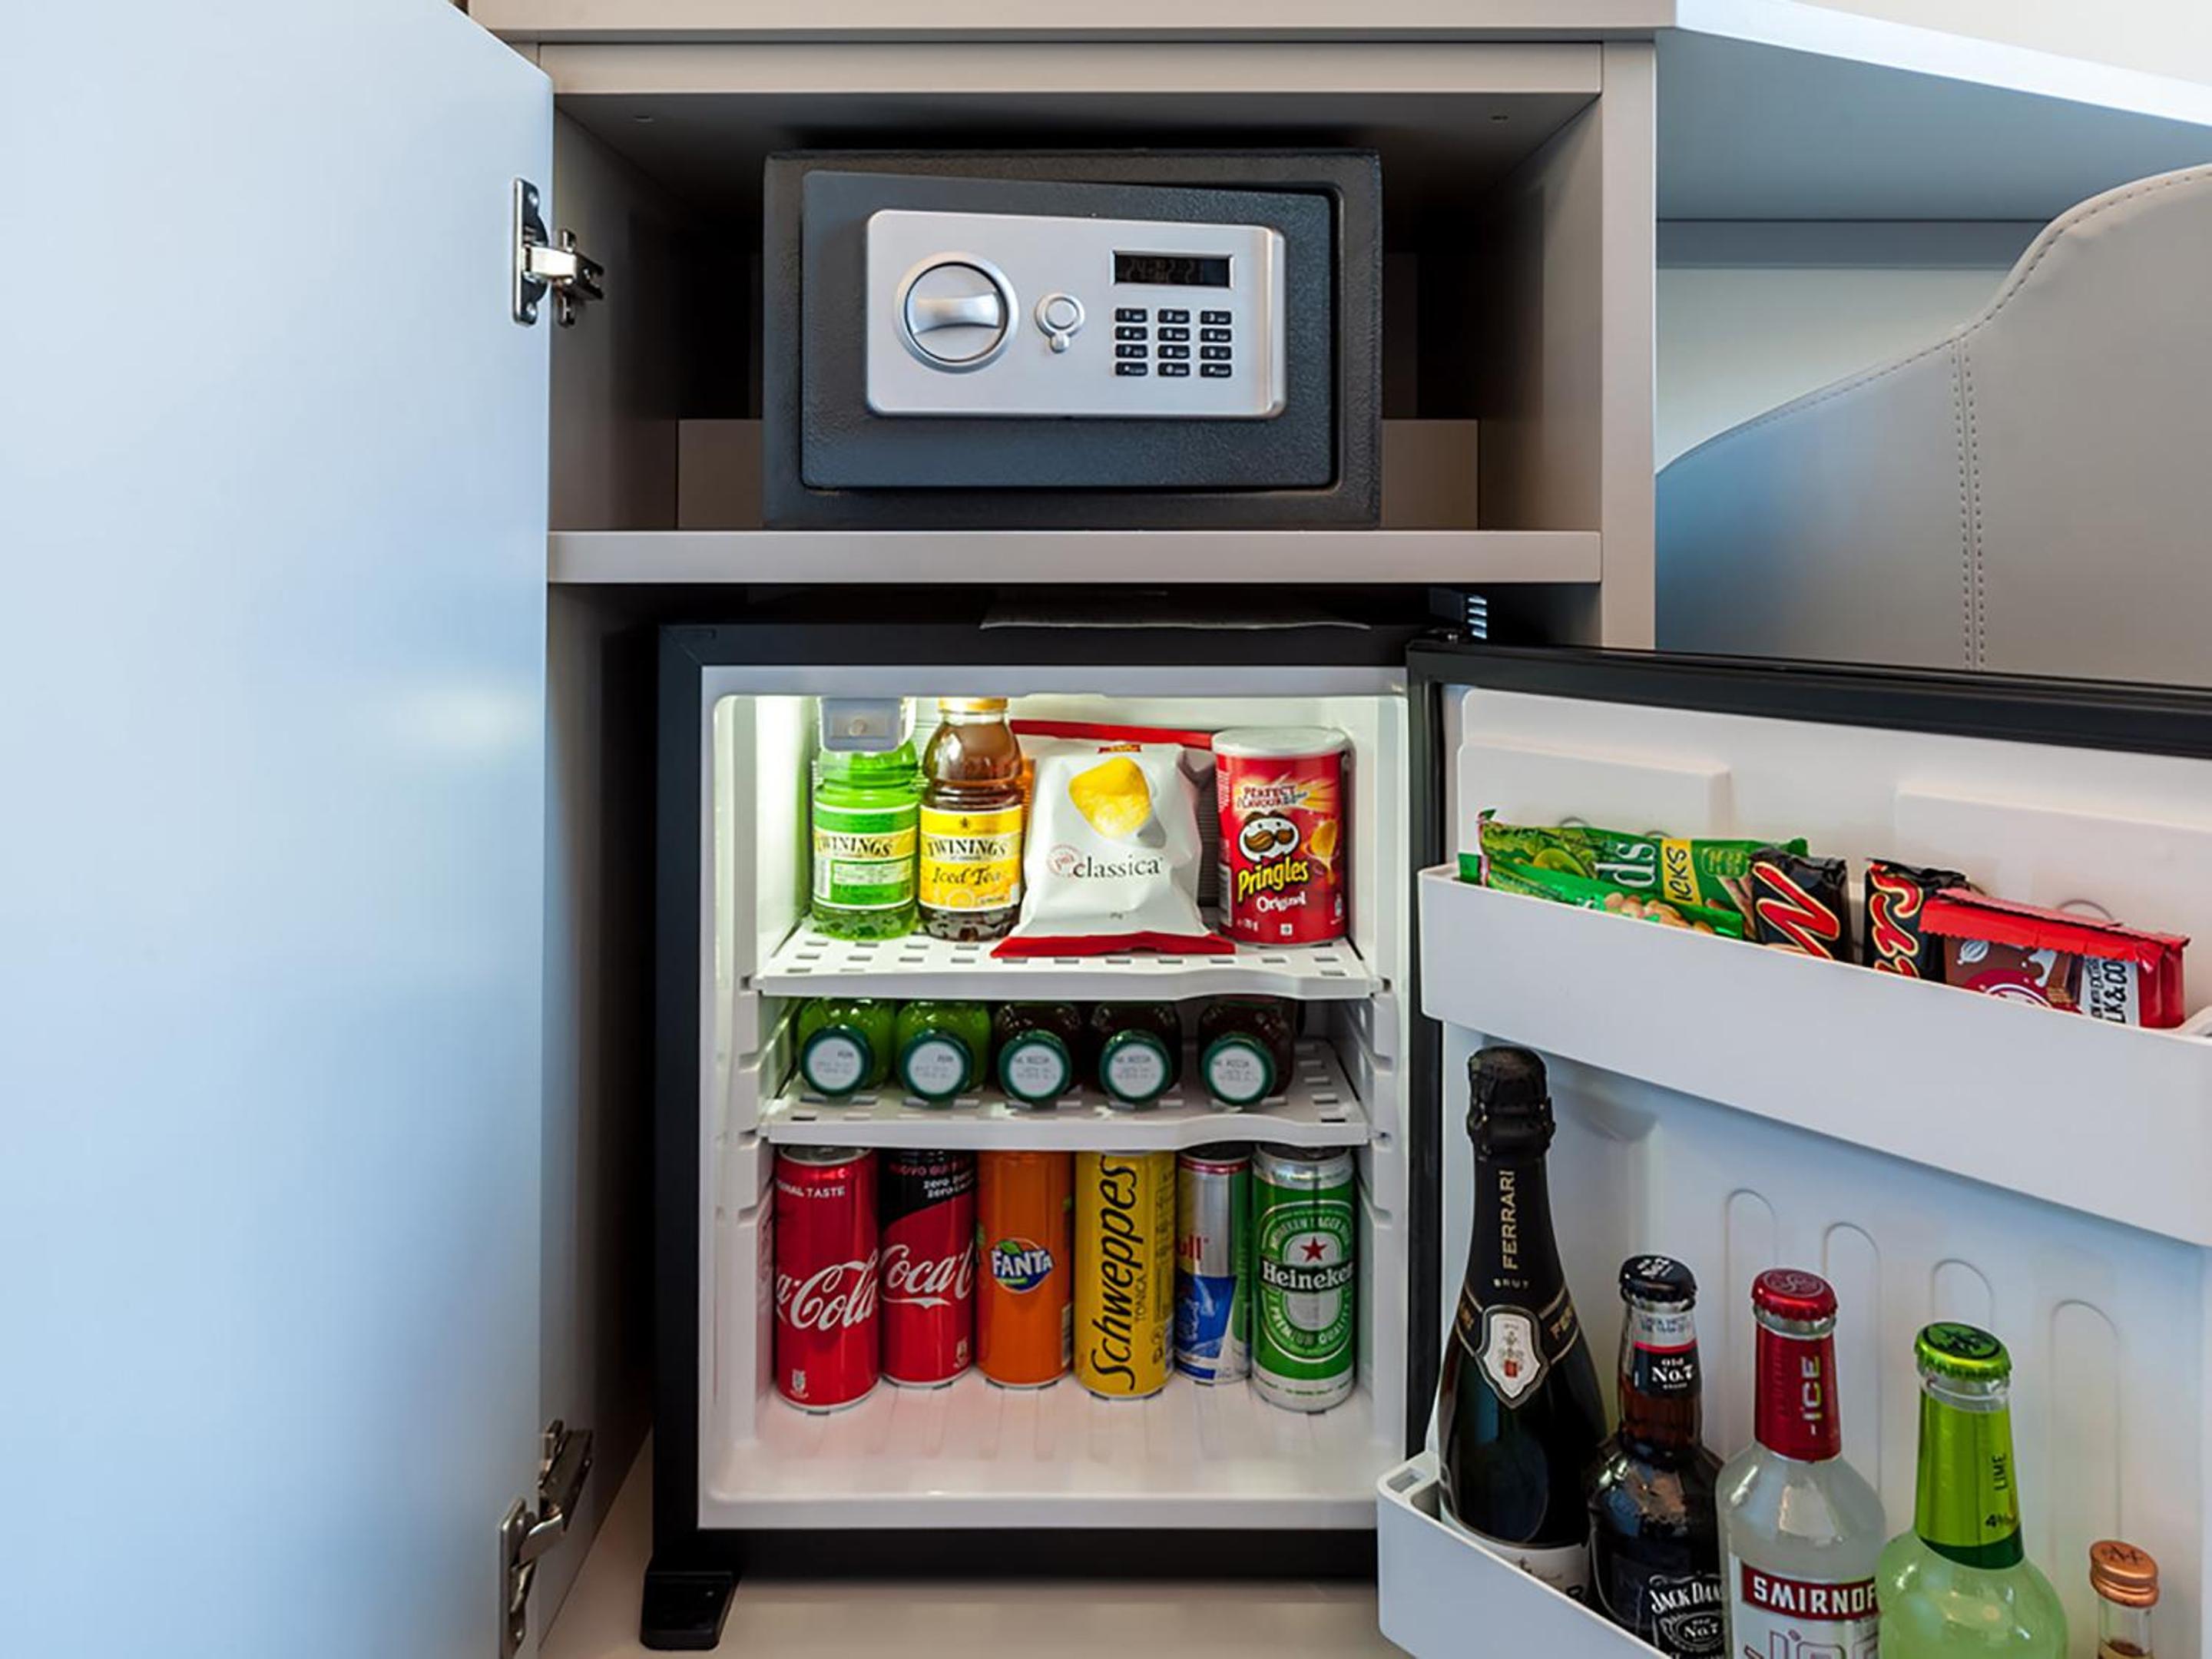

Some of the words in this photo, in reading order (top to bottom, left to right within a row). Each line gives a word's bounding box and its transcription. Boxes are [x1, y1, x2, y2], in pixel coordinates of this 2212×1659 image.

[928, 839, 1008, 856] TWININGS
[932, 866, 971, 884] Iced
[971, 865, 1001, 886] Tea
[1072, 855, 1161, 878] classica
[1237, 856, 1309, 903] Pringles
[1256, 891, 1306, 912] Original
[806, 1185, 846, 1198] TASTE
[1498, 1169, 1518, 1270] FERRARI
[991, 1248, 1053, 1278] FANTA
[1091, 1154, 1144, 1391] Schweppes
[1493, 1277, 1529, 1290] BRUT
[1651, 1364, 1694, 1383] No.7
[1992, 1452, 2008, 1492] LIME
[1650, 1589, 1690, 1614] JACK
